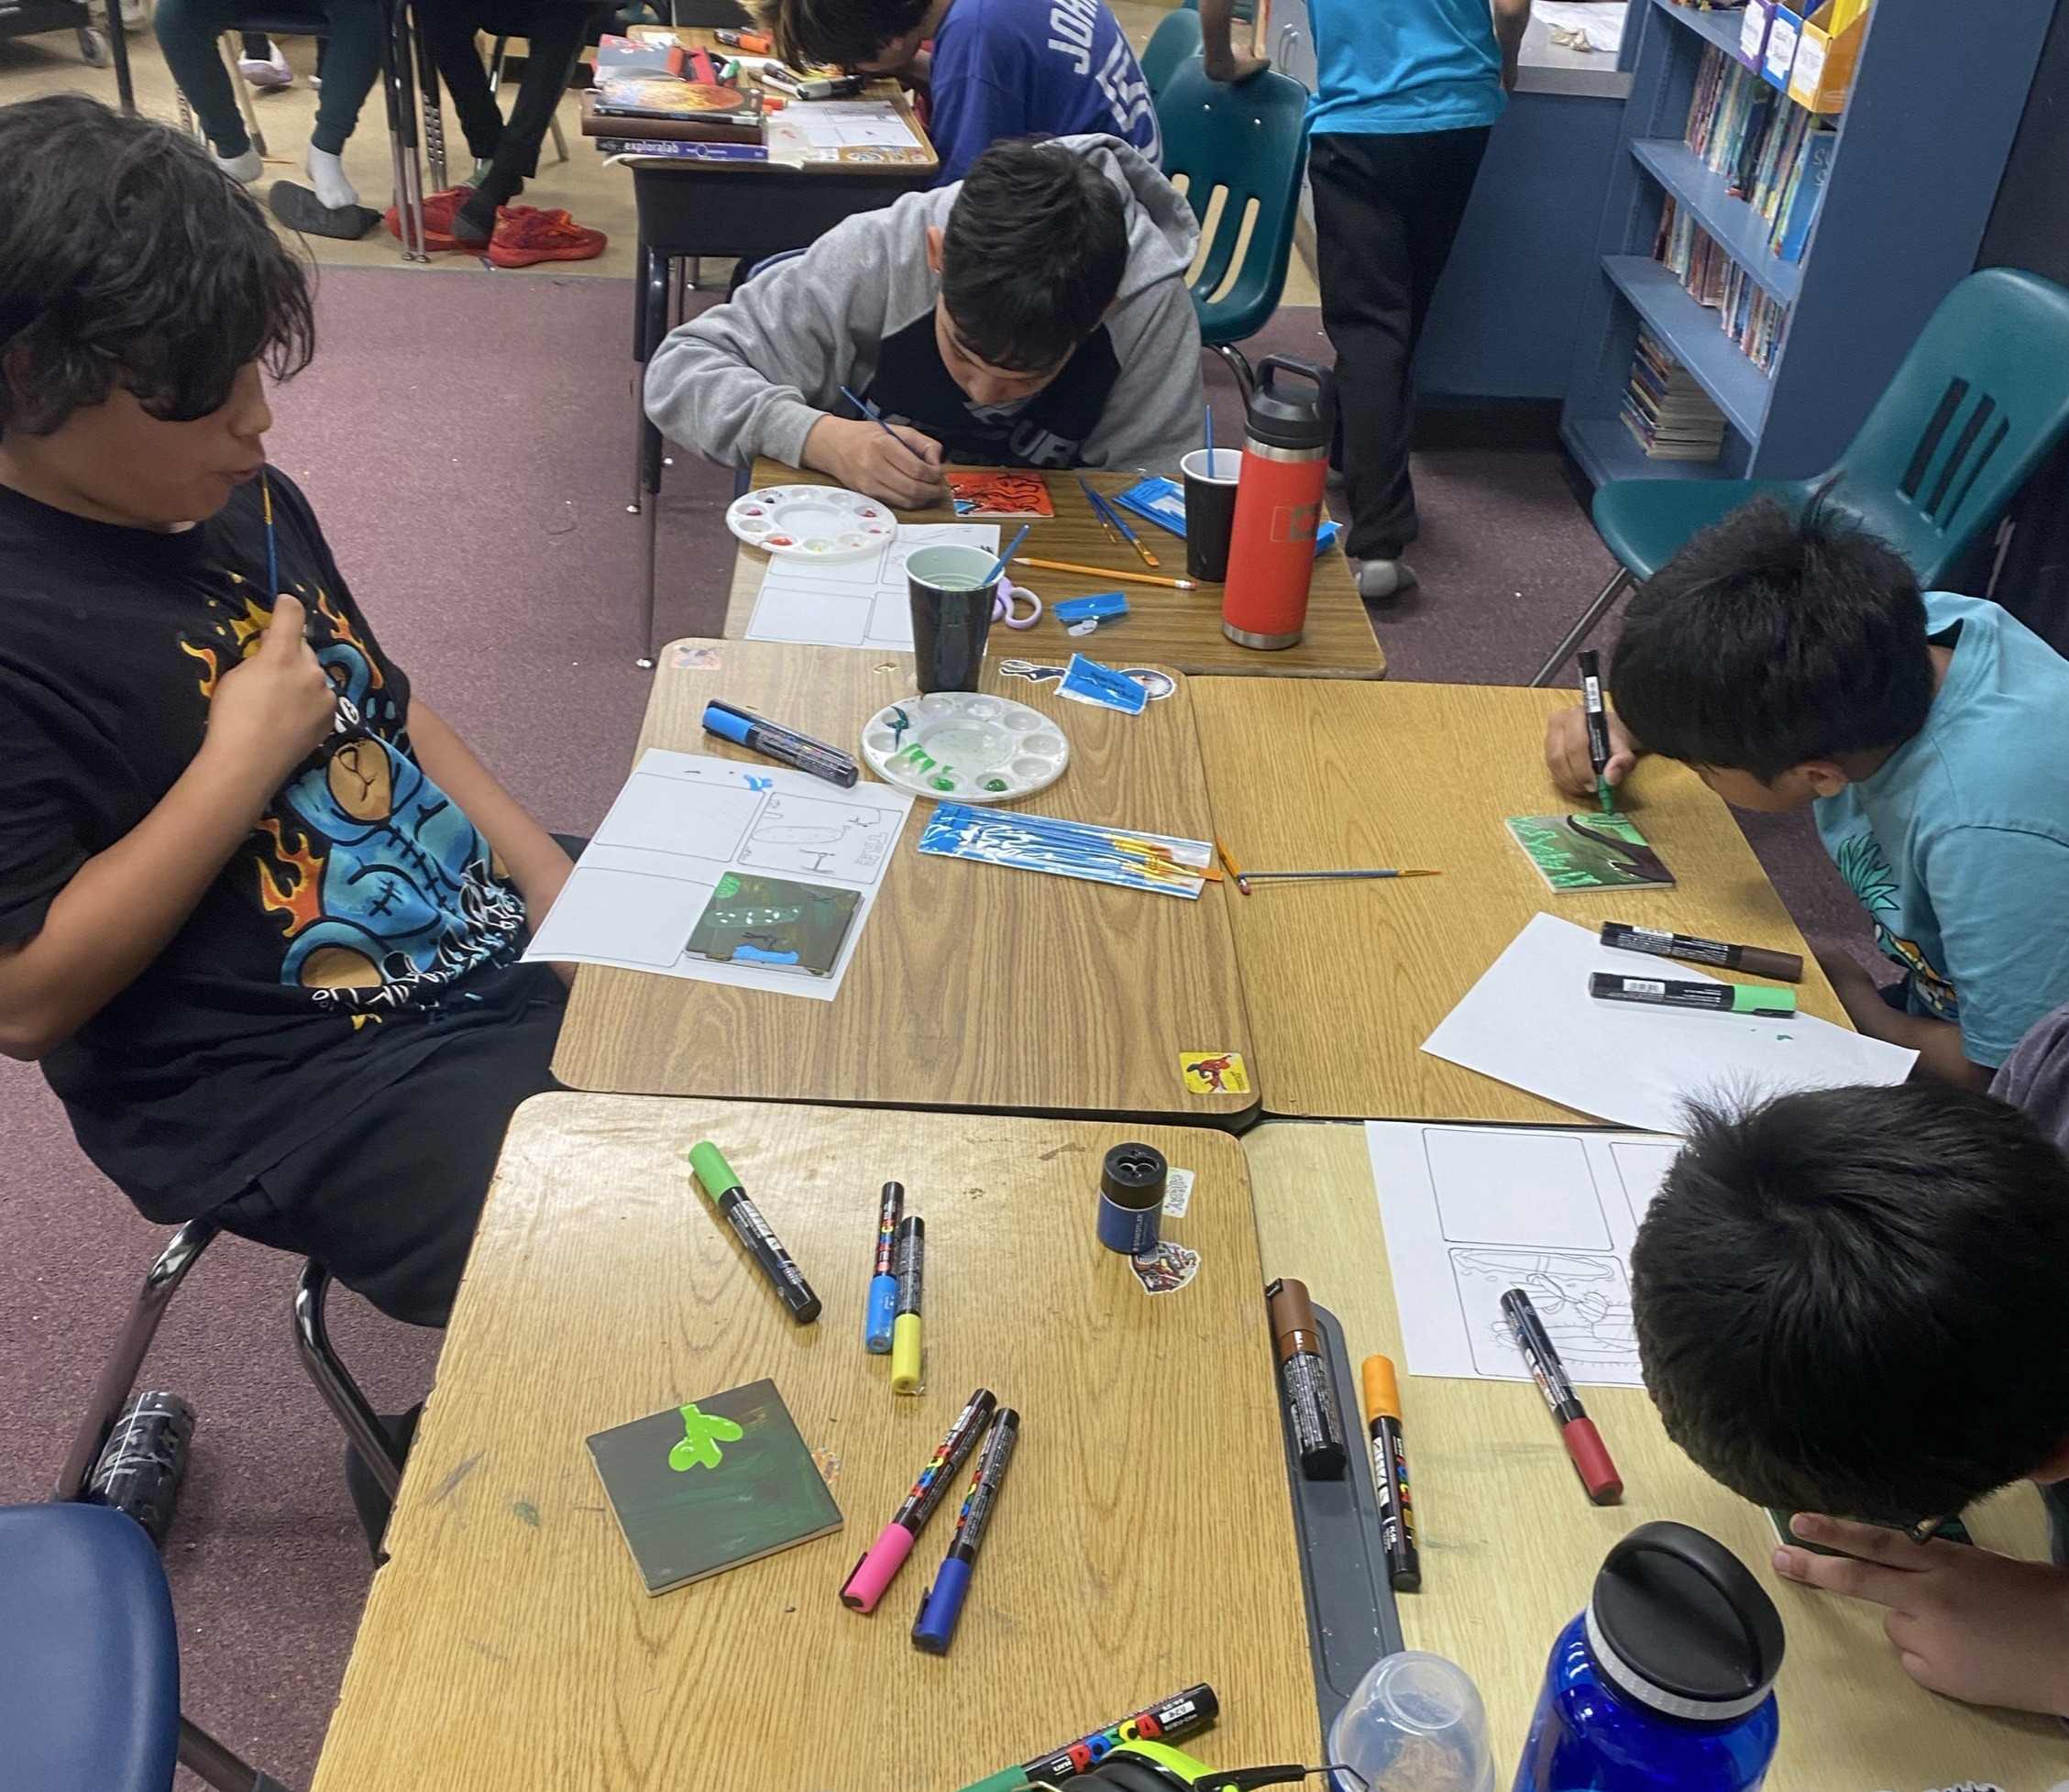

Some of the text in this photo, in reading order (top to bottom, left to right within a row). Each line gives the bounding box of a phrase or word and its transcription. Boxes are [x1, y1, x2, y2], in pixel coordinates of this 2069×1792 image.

[1048, 0, 1099, 75] JOH
[623, 141, 679, 154] exploralab
[1051, 1756, 1072, 1772] uni
[1067, 1712, 1163, 1775] POSCA
